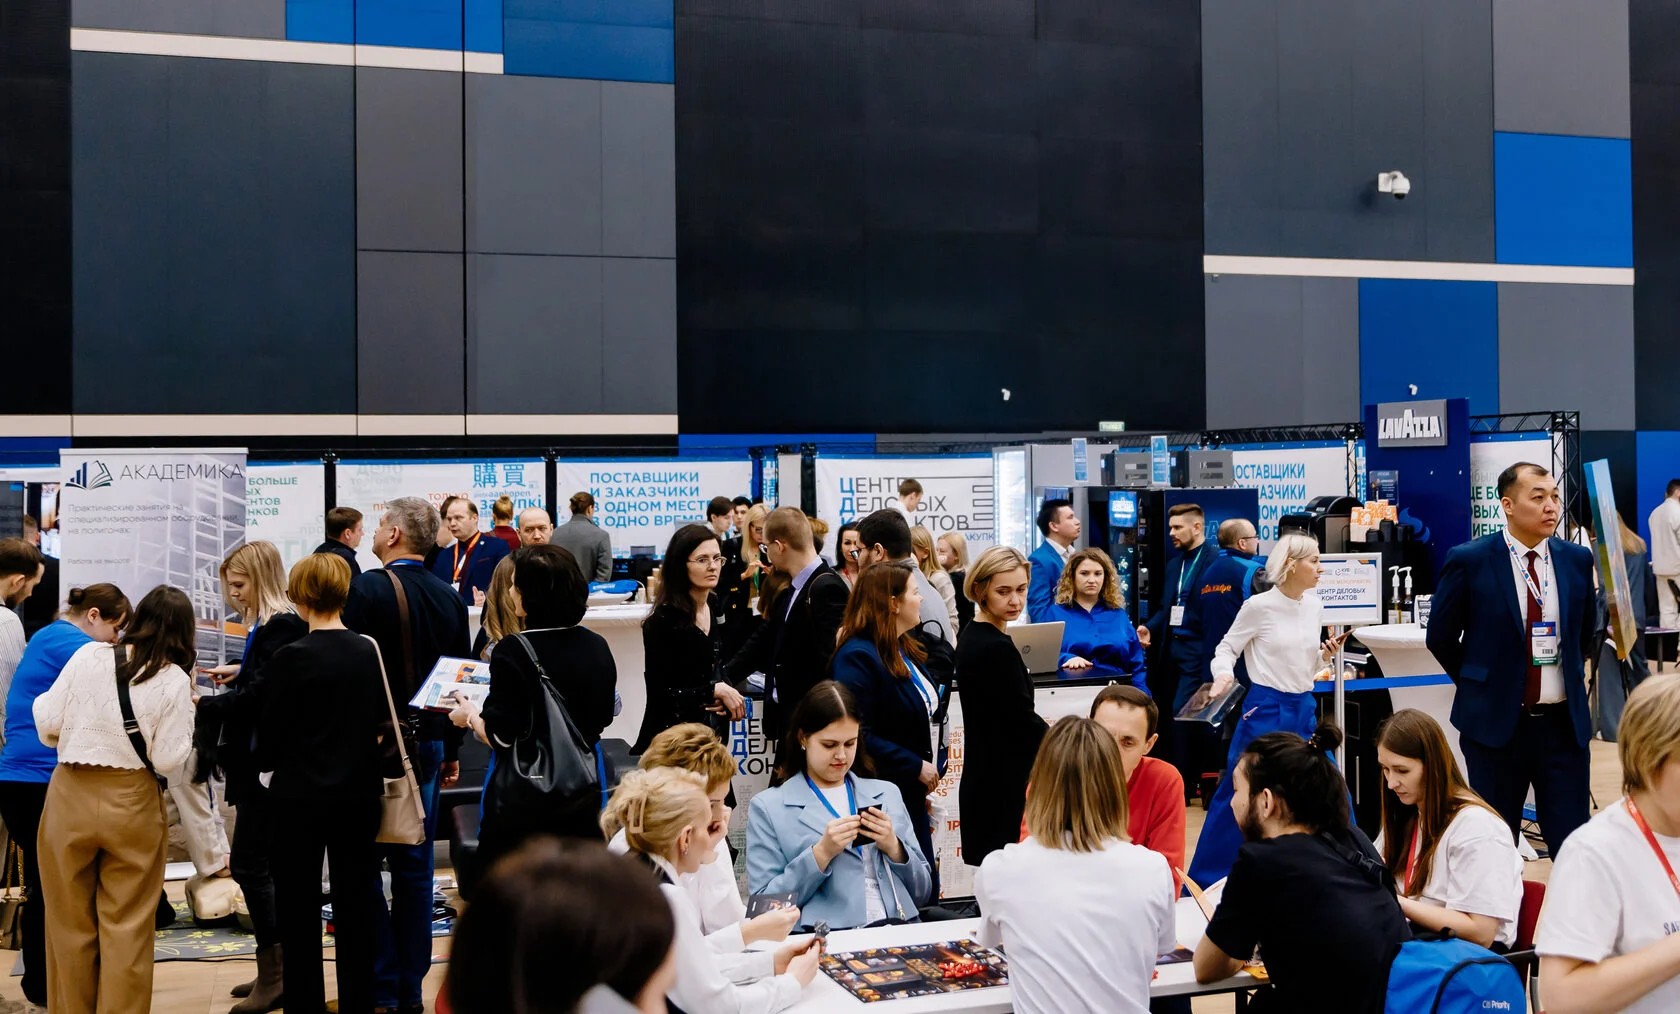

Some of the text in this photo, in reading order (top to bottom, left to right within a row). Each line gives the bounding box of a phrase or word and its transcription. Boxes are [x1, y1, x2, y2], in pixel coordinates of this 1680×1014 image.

[1378, 408, 1441, 440] LAVAZZA
[119, 463, 243, 483] АКАДЕМИКА
[590, 472, 699, 485] ПОСТАВЩИКИ
[248, 476, 298, 486] БОЛЬШЕ
[605, 486, 699, 498] ЗАКАЗЧИКИ
[604, 501, 662, 514] ОДНОМ
[604, 515, 650, 529] ОДНО
[1336, 587, 1366, 595] ДЕЛОВЫХ
